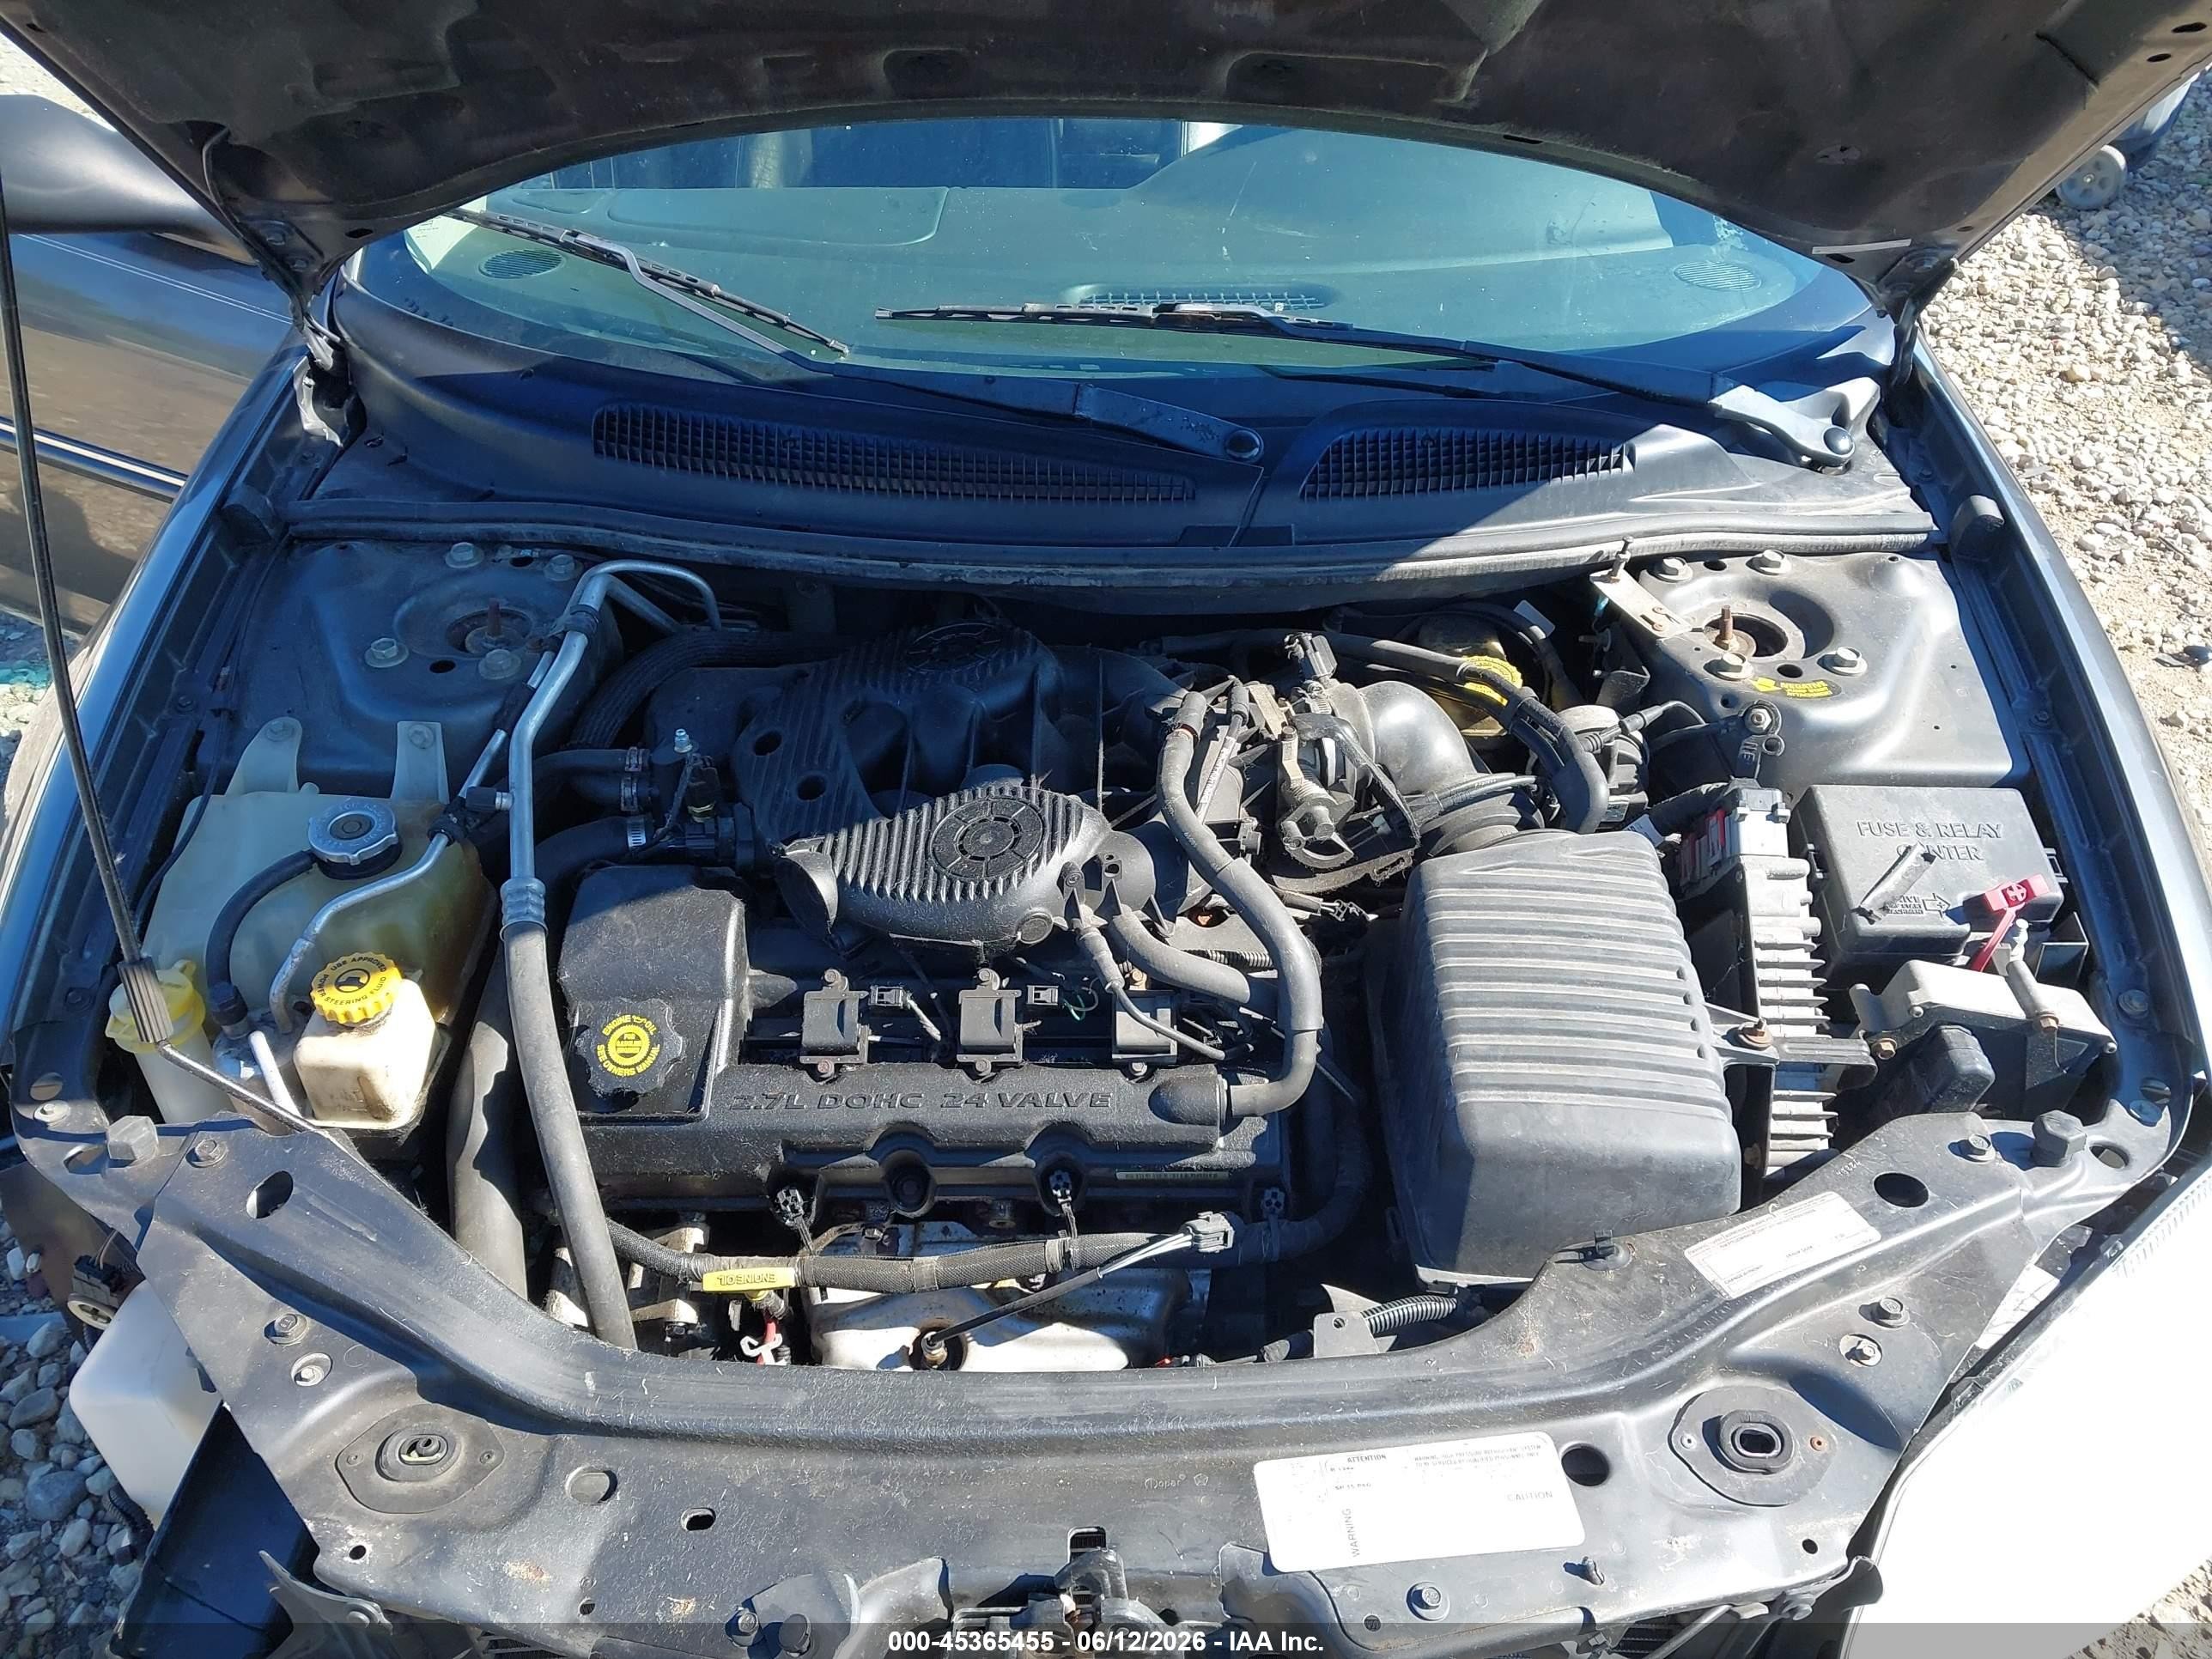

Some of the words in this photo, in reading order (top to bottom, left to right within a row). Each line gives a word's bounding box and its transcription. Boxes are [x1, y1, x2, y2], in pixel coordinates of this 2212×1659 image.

[1856, 820, 1910, 837] FUSE
[1916, 822, 1931, 838] &
[1936, 822, 2002, 839] RELAY
[1896, 843, 1984, 860] CNTER
[331, 960, 349, 971] USE
[350, 956, 387, 973] APPROVED
[316, 974, 329, 998] POWER
[370, 976, 386, 995] FLUID
[324, 994, 368, 1006] STEERING
[602, 1014, 632, 1036] ENGINE
[645, 1021, 659, 1036] OIL
[597, 1044, 607, 1062] SEE
[635, 1043, 660, 1073] MANUAL
[730, 1093, 806, 1110] 2.7L
[817, 1092, 925, 1109] DOHC
[940, 1091, 989, 1109] 24
[998, 1091, 1114, 1109] VALVE
[1347, 1454, 1387, 1463] ATTENTION
[1507, 1491, 1553, 1502] CAUTION
[1341, 1508, 1360, 1558] WARNING
